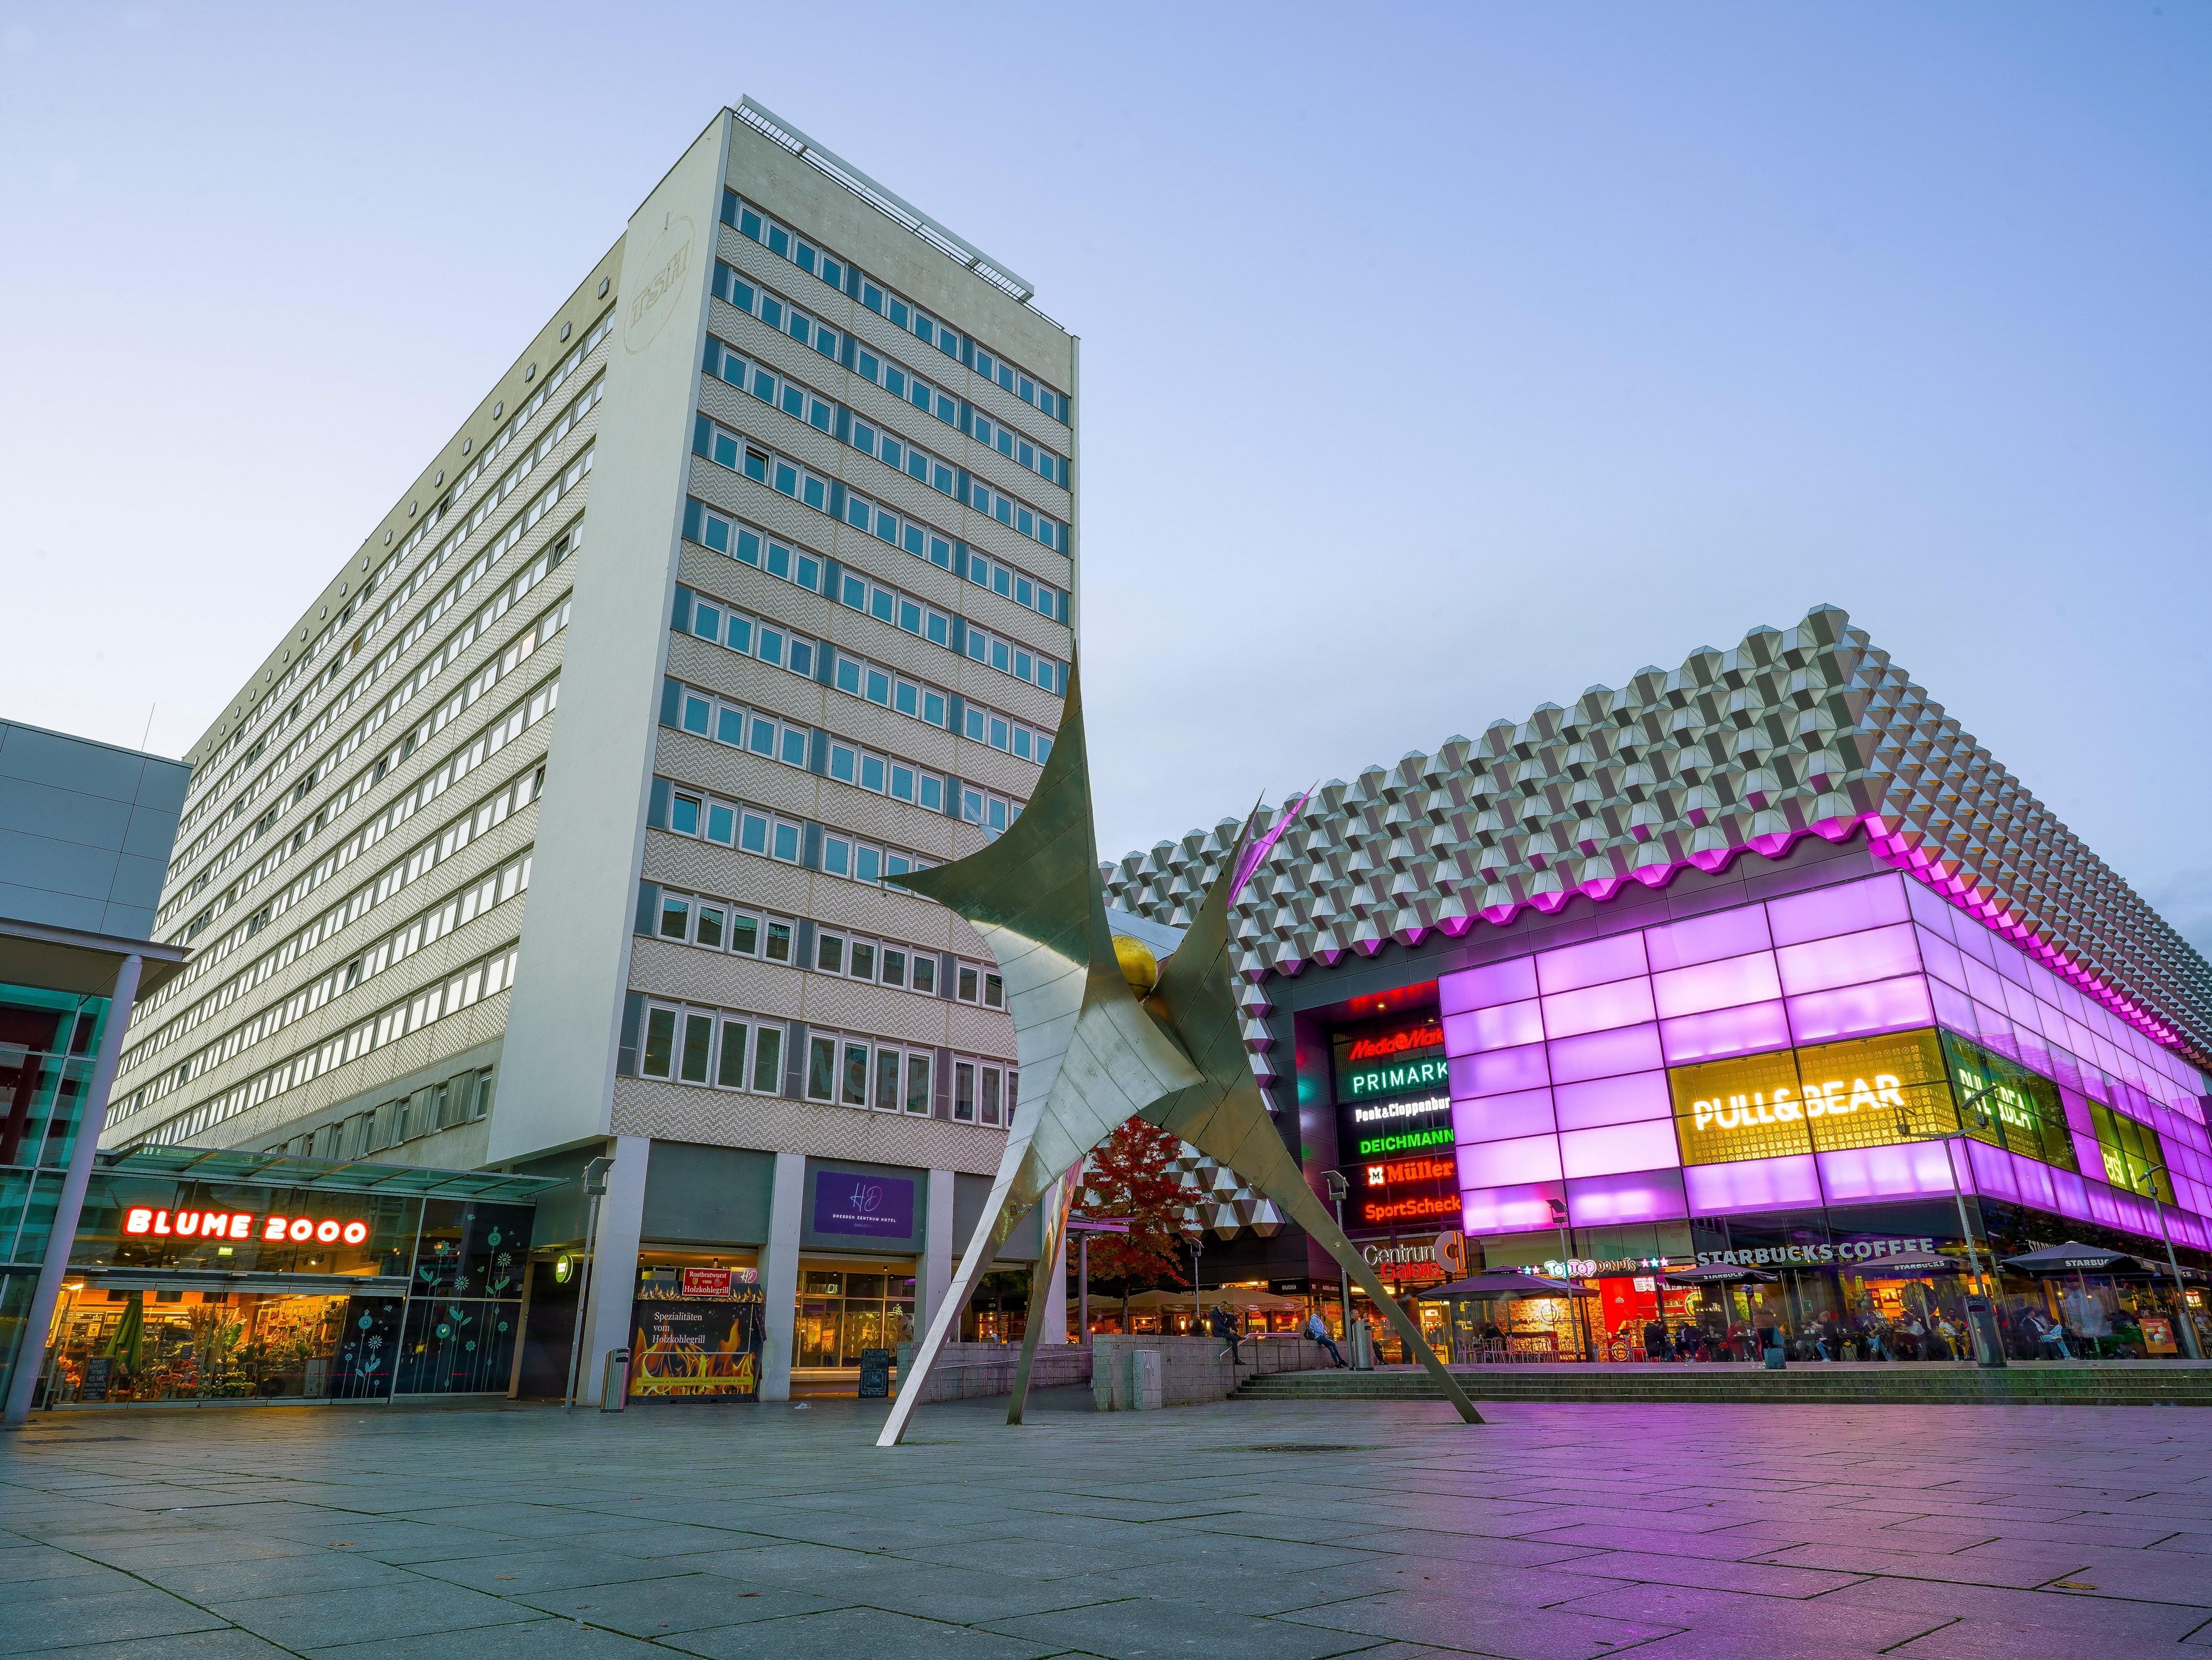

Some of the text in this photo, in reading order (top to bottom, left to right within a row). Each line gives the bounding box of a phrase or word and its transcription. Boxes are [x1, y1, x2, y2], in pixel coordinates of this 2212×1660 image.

[1353, 1061, 1448, 1094] PRIMARK
[1355, 1097, 1451, 1122] Peek&Cloppenbur
[1693, 1074, 1906, 1131] PULL&BEAR
[1360, 1129, 1454, 1154] DEICHMANN
[1386, 1161, 1454, 1183] Müller
[1365, 1195, 1462, 1221] SportScheck
[124, 1206, 369, 1247] BLUME 2000
[1697, 1238, 1935, 1267] STARBUCKS COFFEE
[1381, 1259, 1441, 1279] Galerie
[1894, 1261, 1945, 1271] STARBUCKS
[684, 1286, 729, 1294] Holzkohlegrill
[654, 1312, 703, 1322] Spezialitäten
[653, 1335, 706, 1345] Holzkohlegrill
